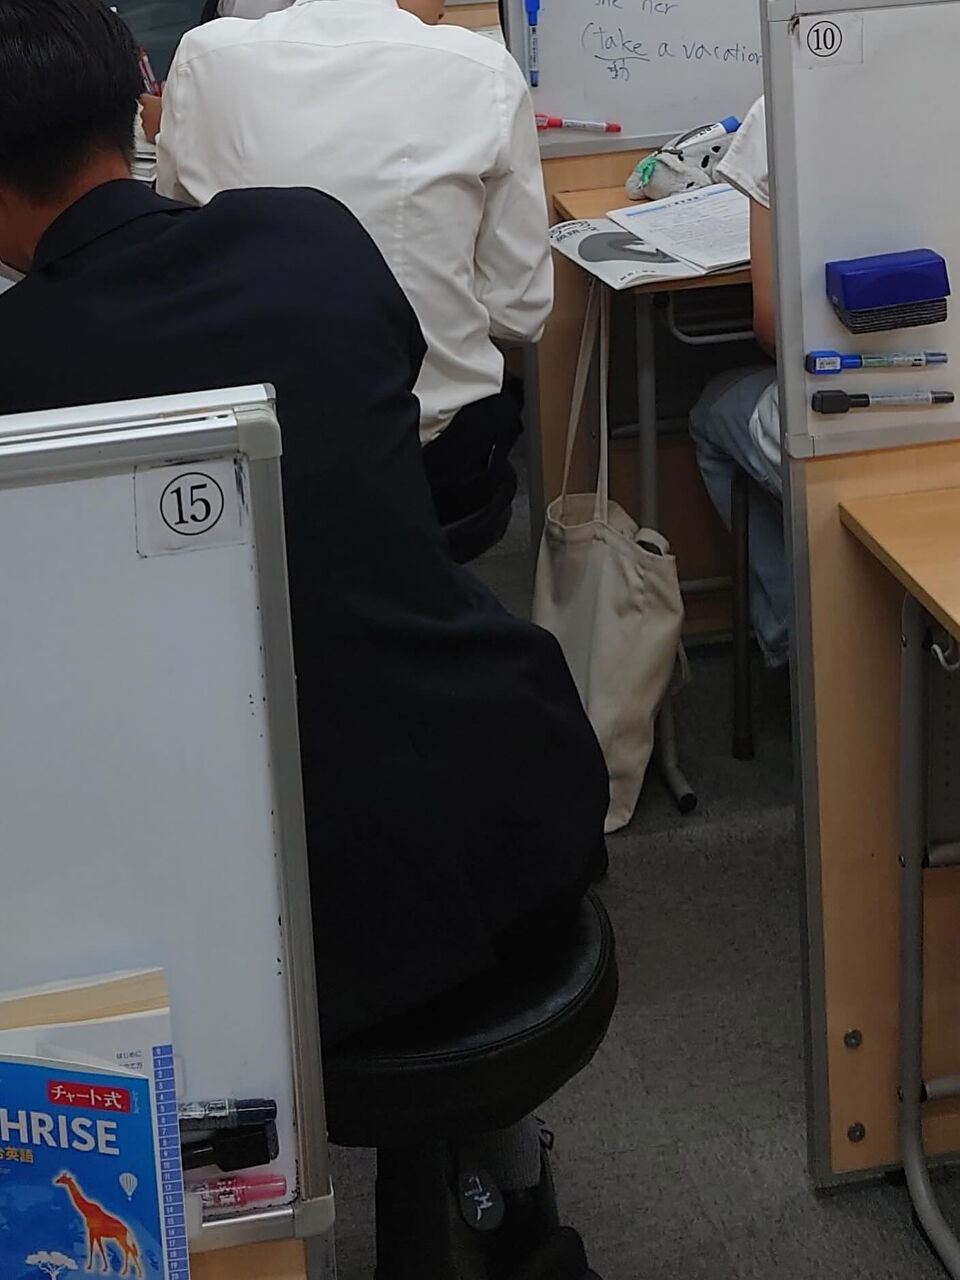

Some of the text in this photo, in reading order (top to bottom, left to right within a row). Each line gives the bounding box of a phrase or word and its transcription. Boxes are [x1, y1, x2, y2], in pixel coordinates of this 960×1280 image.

[657, 42, 675, 58] a
[50, 1084, 123, 1110] チャート式
